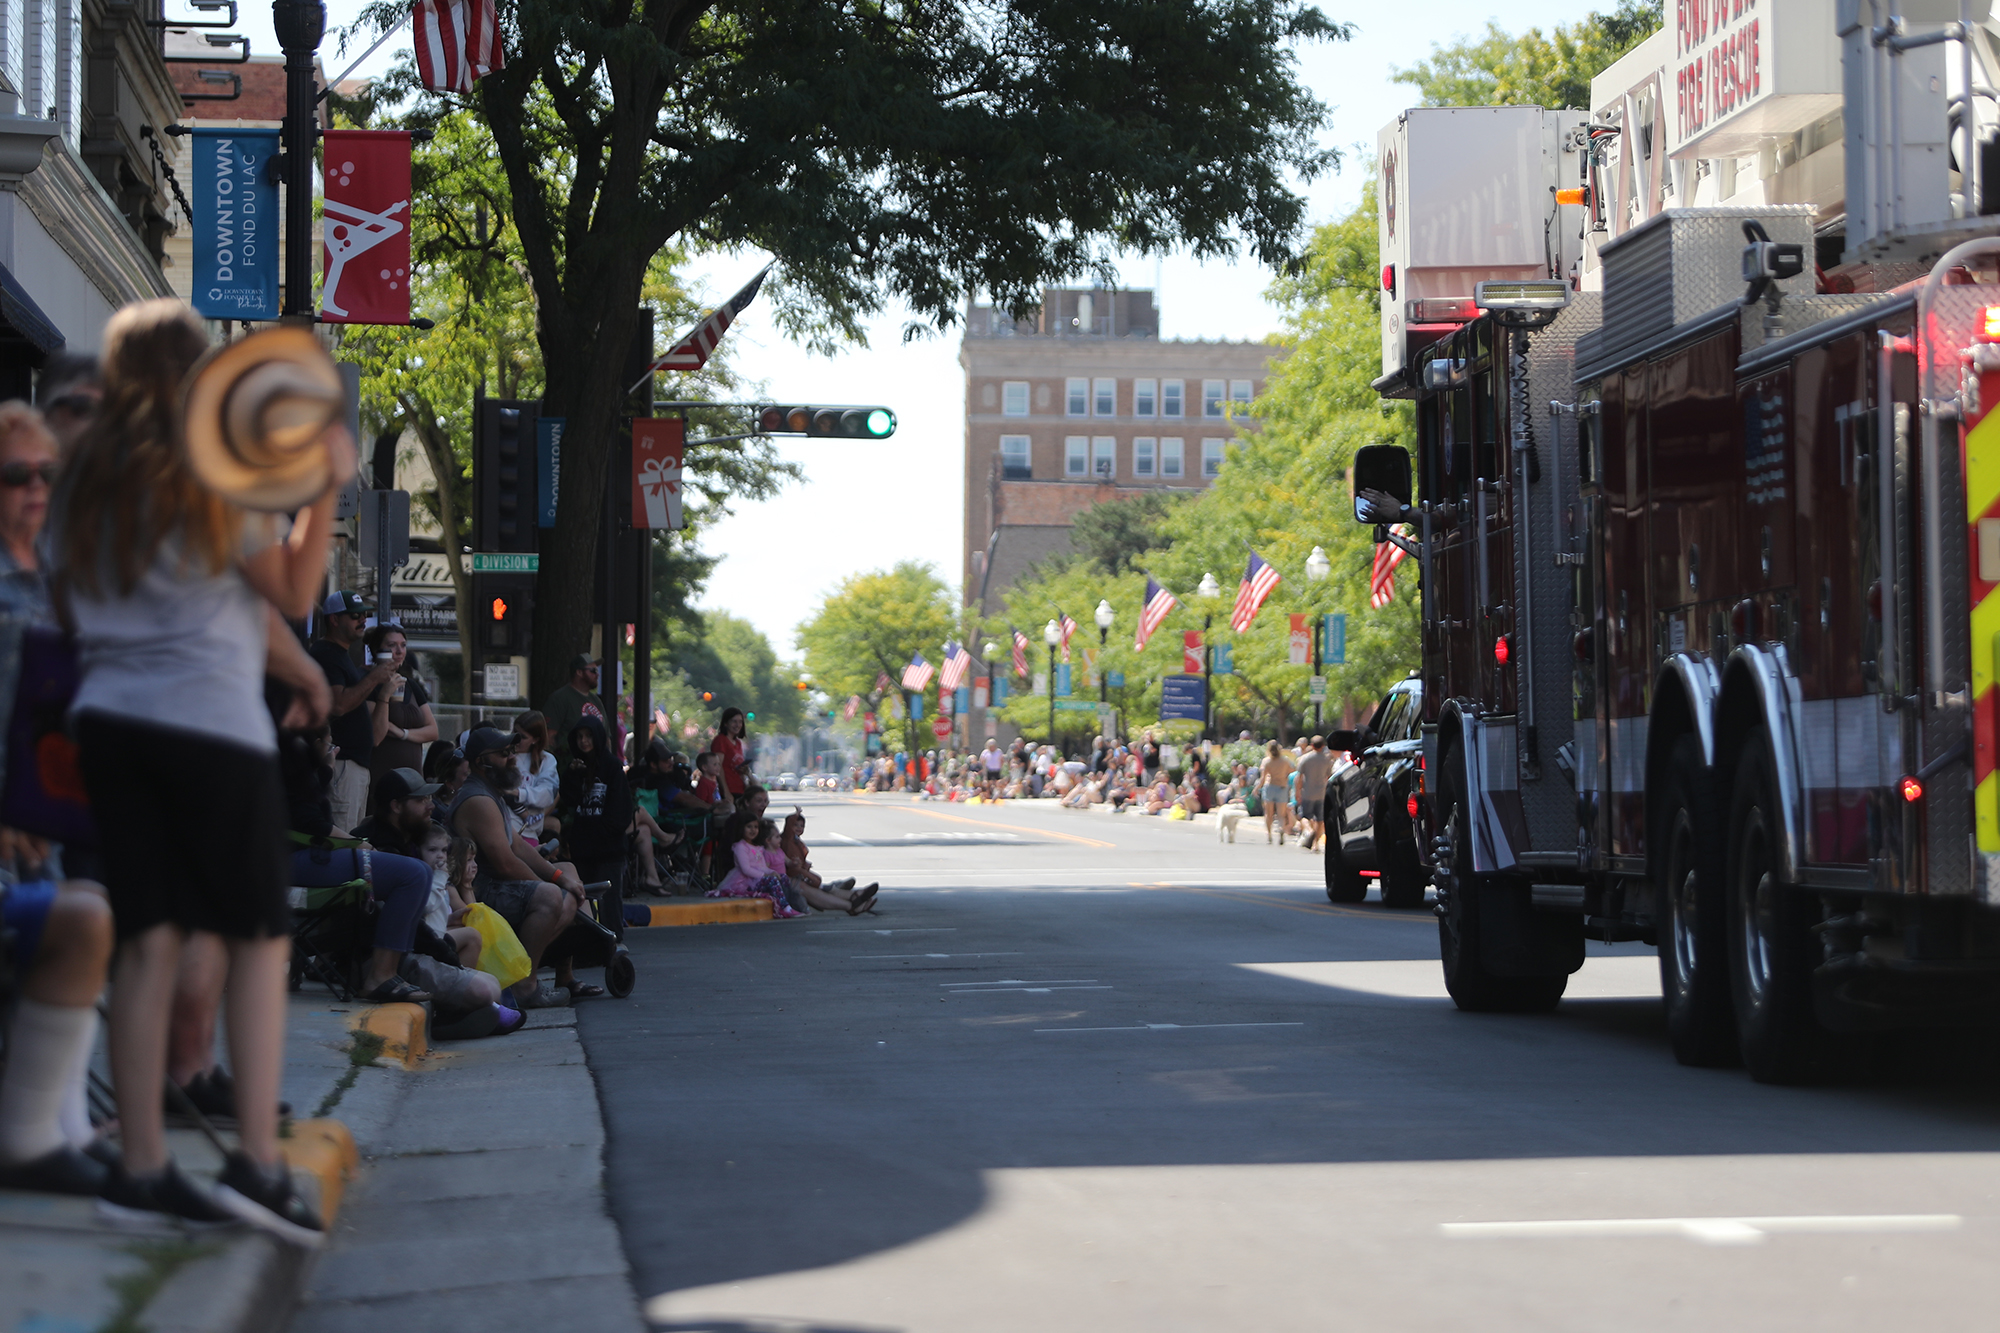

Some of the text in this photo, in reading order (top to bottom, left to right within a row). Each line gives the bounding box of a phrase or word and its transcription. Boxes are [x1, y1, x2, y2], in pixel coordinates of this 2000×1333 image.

[216, 139, 234, 281] DOWNTOWN
[242, 154, 256, 266] FOND DU LAC
[482, 555, 529, 569] DIVISION
[391, 608, 458, 620] STOMER PARK
